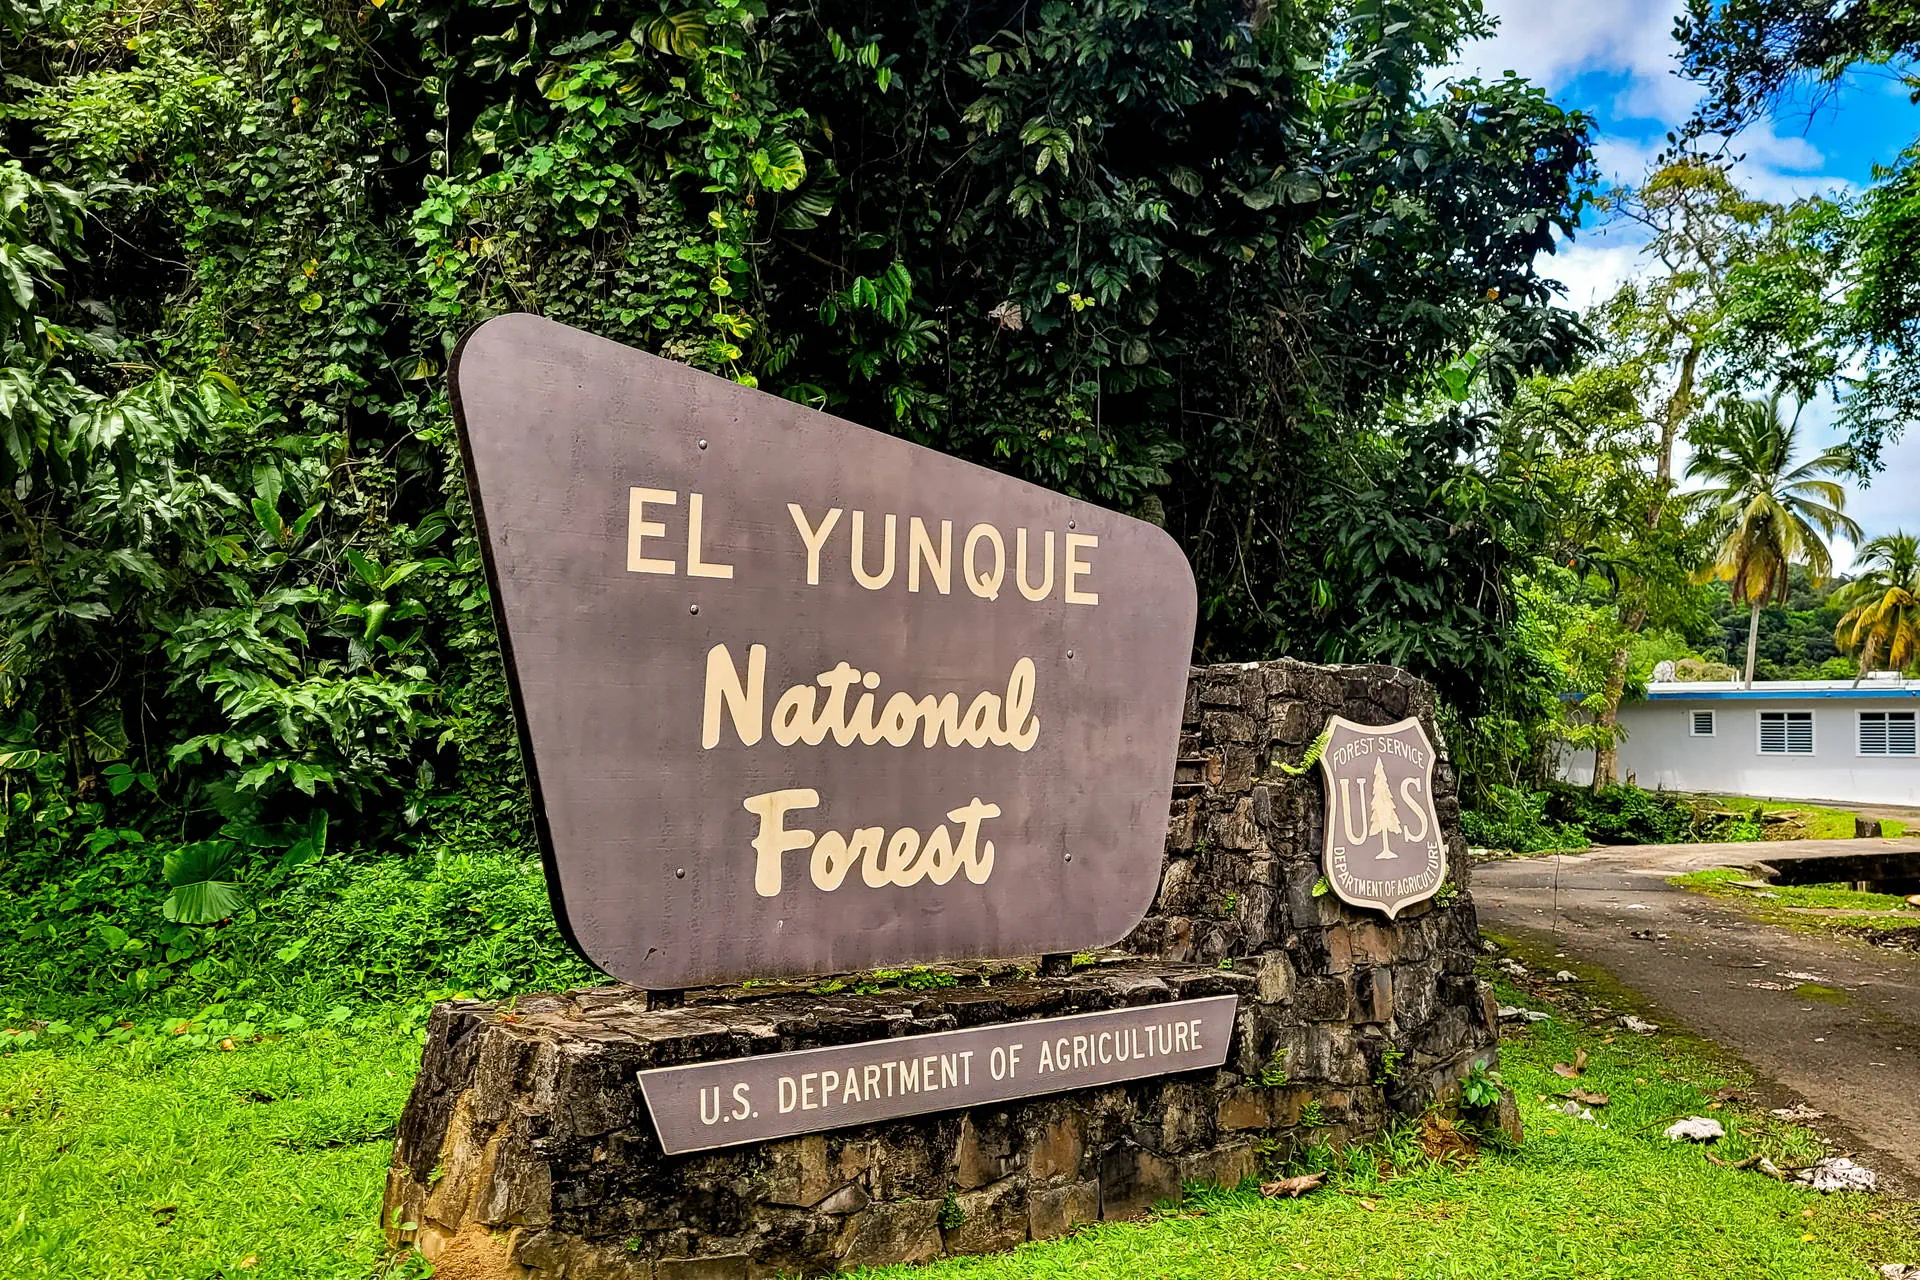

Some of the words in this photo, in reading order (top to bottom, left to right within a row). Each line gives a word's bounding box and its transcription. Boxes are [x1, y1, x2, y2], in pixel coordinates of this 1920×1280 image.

[627, 486, 734, 579] EL
[787, 503, 1099, 606] YUNQUE
[702, 643, 1040, 752] National
[1333, 737, 1375, 772] FOREST
[1378, 736, 1425, 770] SERVICE
[743, 788, 1002, 897] Forest
[1333, 846, 1384, 898] DEPARTMENT
[1384, 880, 1396, 897] OF
[1397, 841, 1439, 897] AGRICULTURE
[699, 1081, 758, 1126] U.S.
[777, 1050, 974, 1115] DEPARTMENT
[989, 1042, 1022, 1082] OF
[1037, 1019, 1204, 1075] AGRICULTURE
